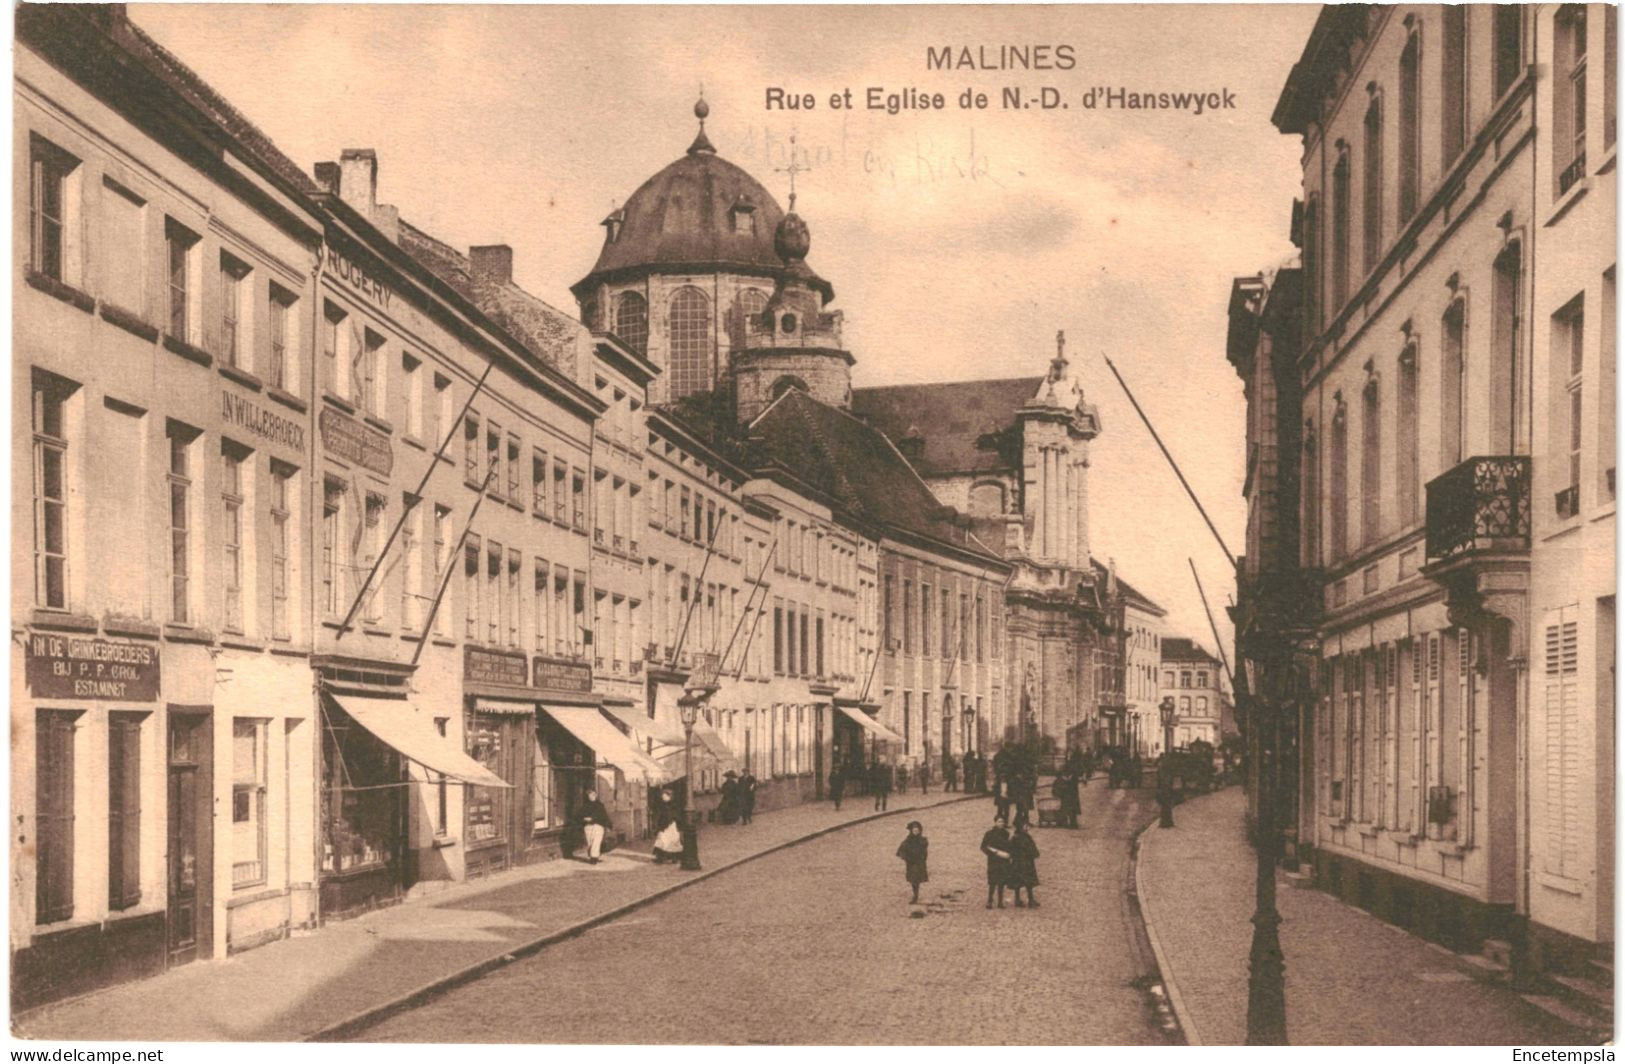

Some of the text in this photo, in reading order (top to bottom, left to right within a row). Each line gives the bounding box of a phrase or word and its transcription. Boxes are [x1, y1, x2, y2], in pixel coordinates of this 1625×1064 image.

[33, 636, 45, 656] IN
[50, 638, 63, 658] DE
[53, 661, 72, 676] BIJ
[75, 679, 127, 697] ESTAMINET
